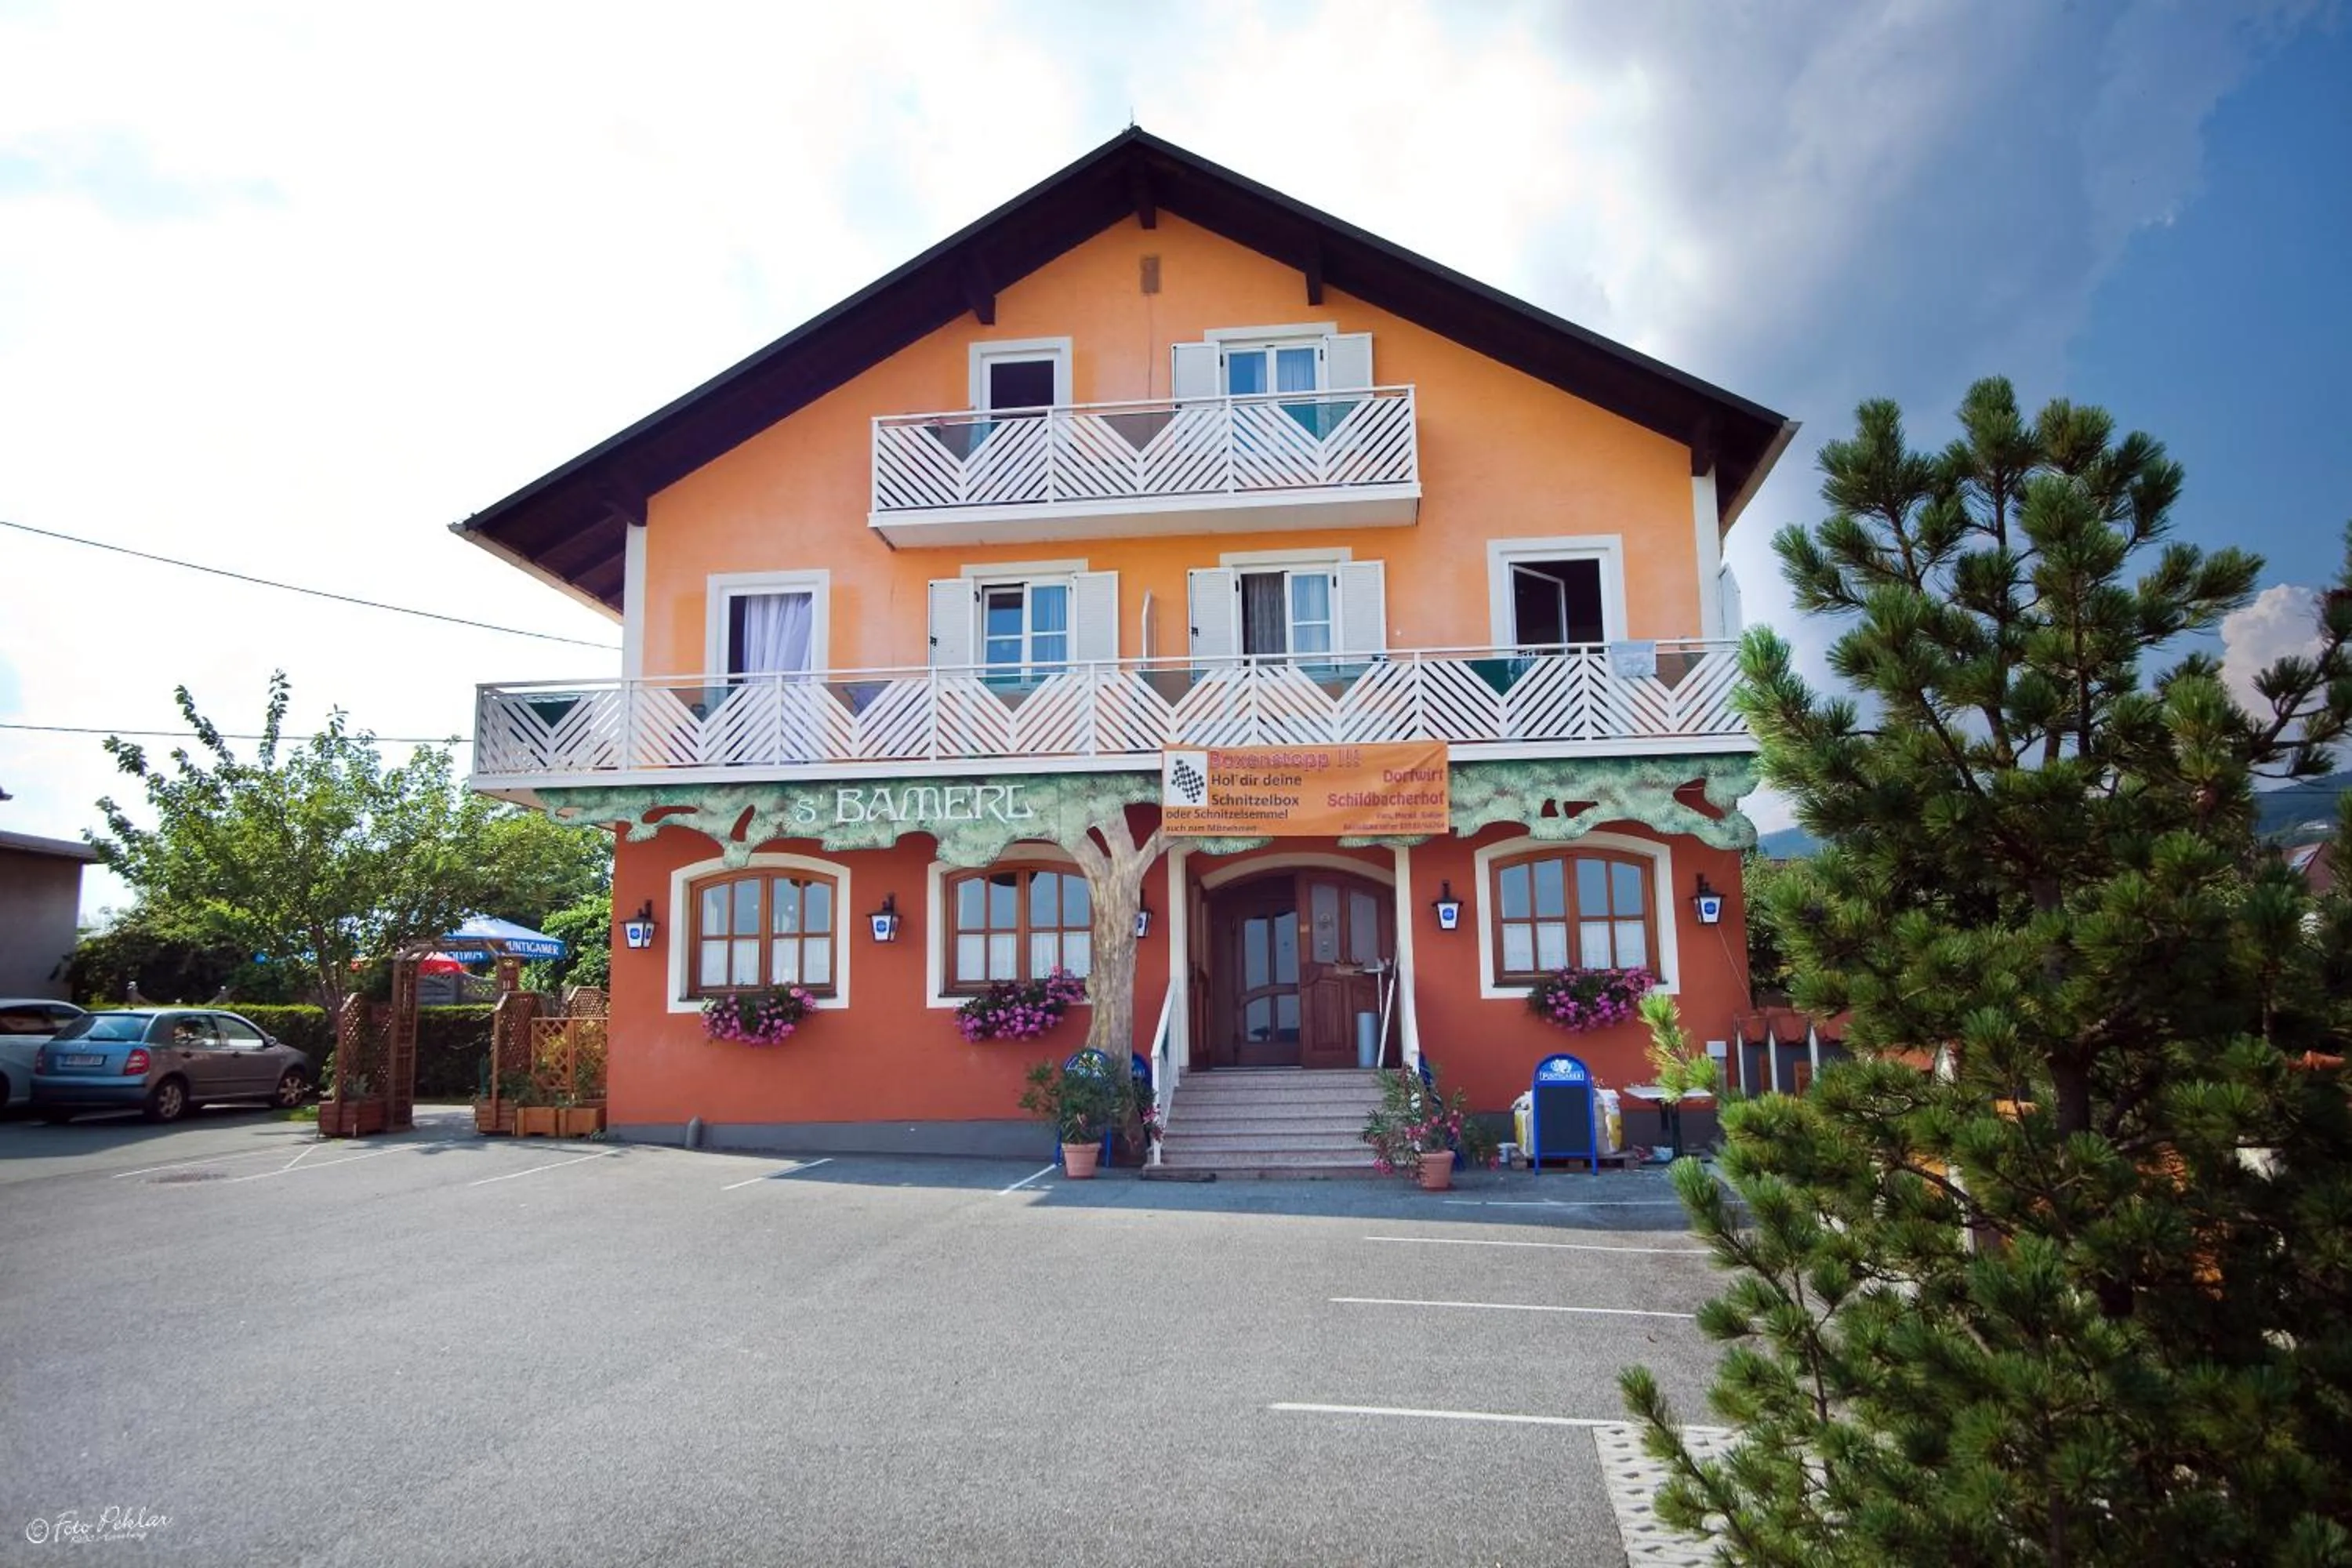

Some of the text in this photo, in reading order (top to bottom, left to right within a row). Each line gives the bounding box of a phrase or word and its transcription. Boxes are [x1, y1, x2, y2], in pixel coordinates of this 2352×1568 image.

[1209, 750, 1330, 772] Boxenstopp
[1263, 774, 1302, 786] deine
[1382, 768, 1444, 783] Dorfwirt
[1211, 793, 1299, 807] Schnitzelbox
[1327, 789, 1446, 808] Schildbacherhof
[1166, 808, 1288, 819] oder Schnitzelsemmel
